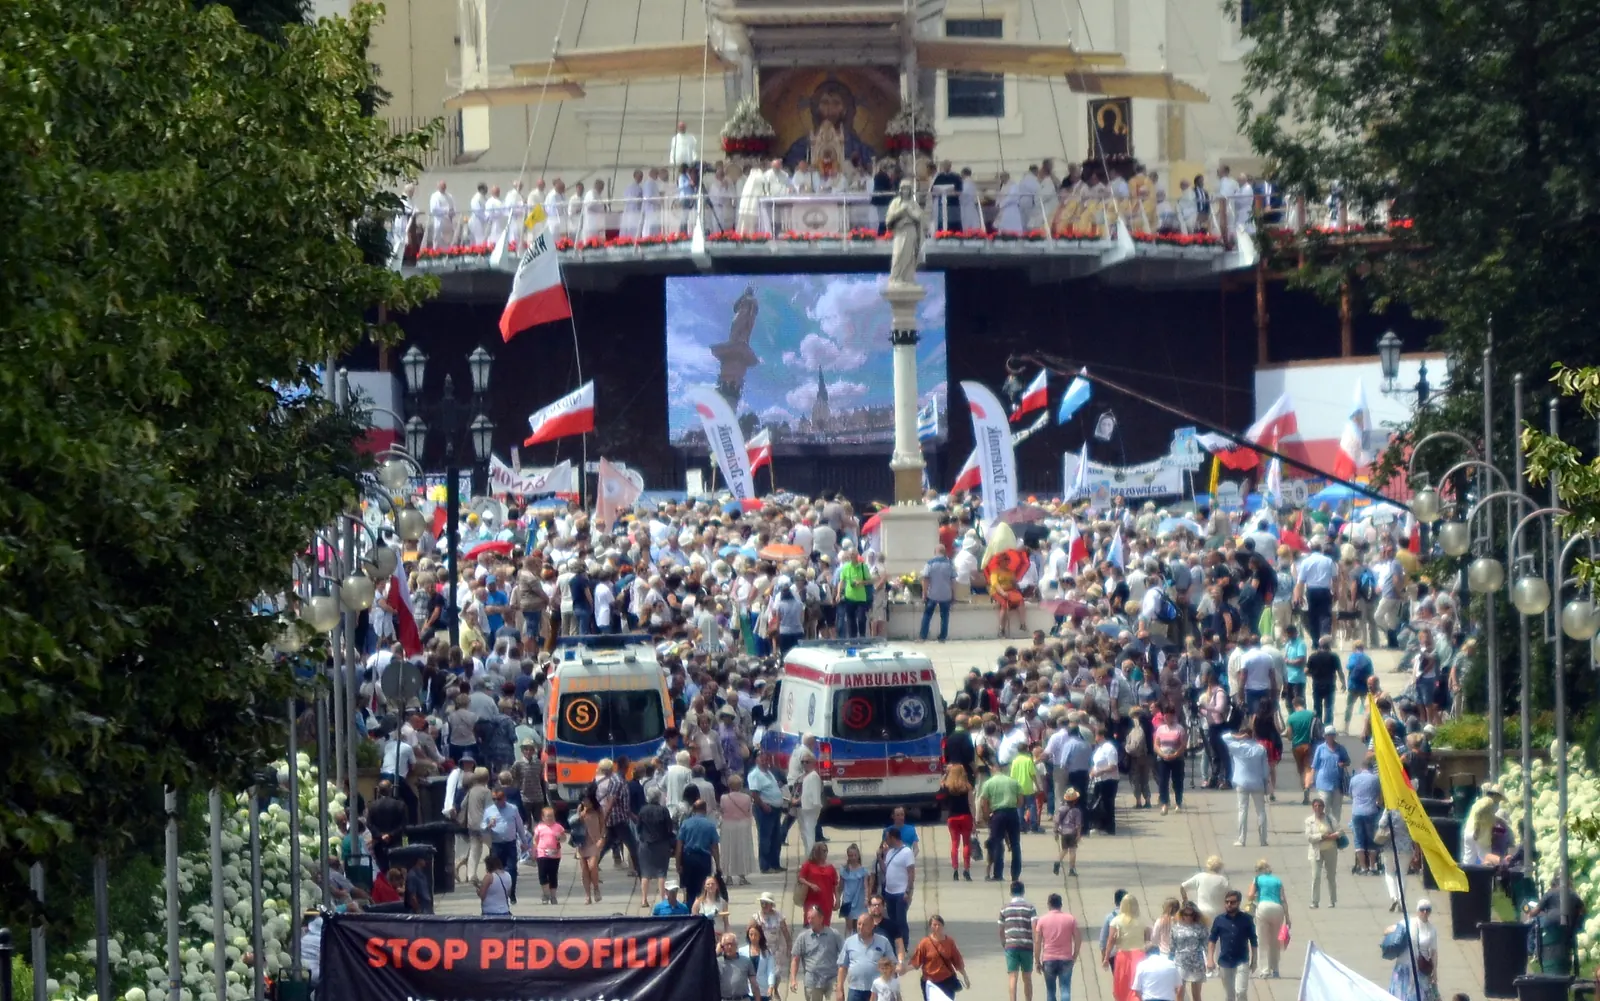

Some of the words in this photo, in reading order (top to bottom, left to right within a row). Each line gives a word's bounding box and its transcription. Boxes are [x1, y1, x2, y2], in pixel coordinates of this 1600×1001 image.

[844, 670, 918, 687] AMBULANS
[365, 936, 468, 970] STOP
[480, 936, 671, 970] PEDOFILII
